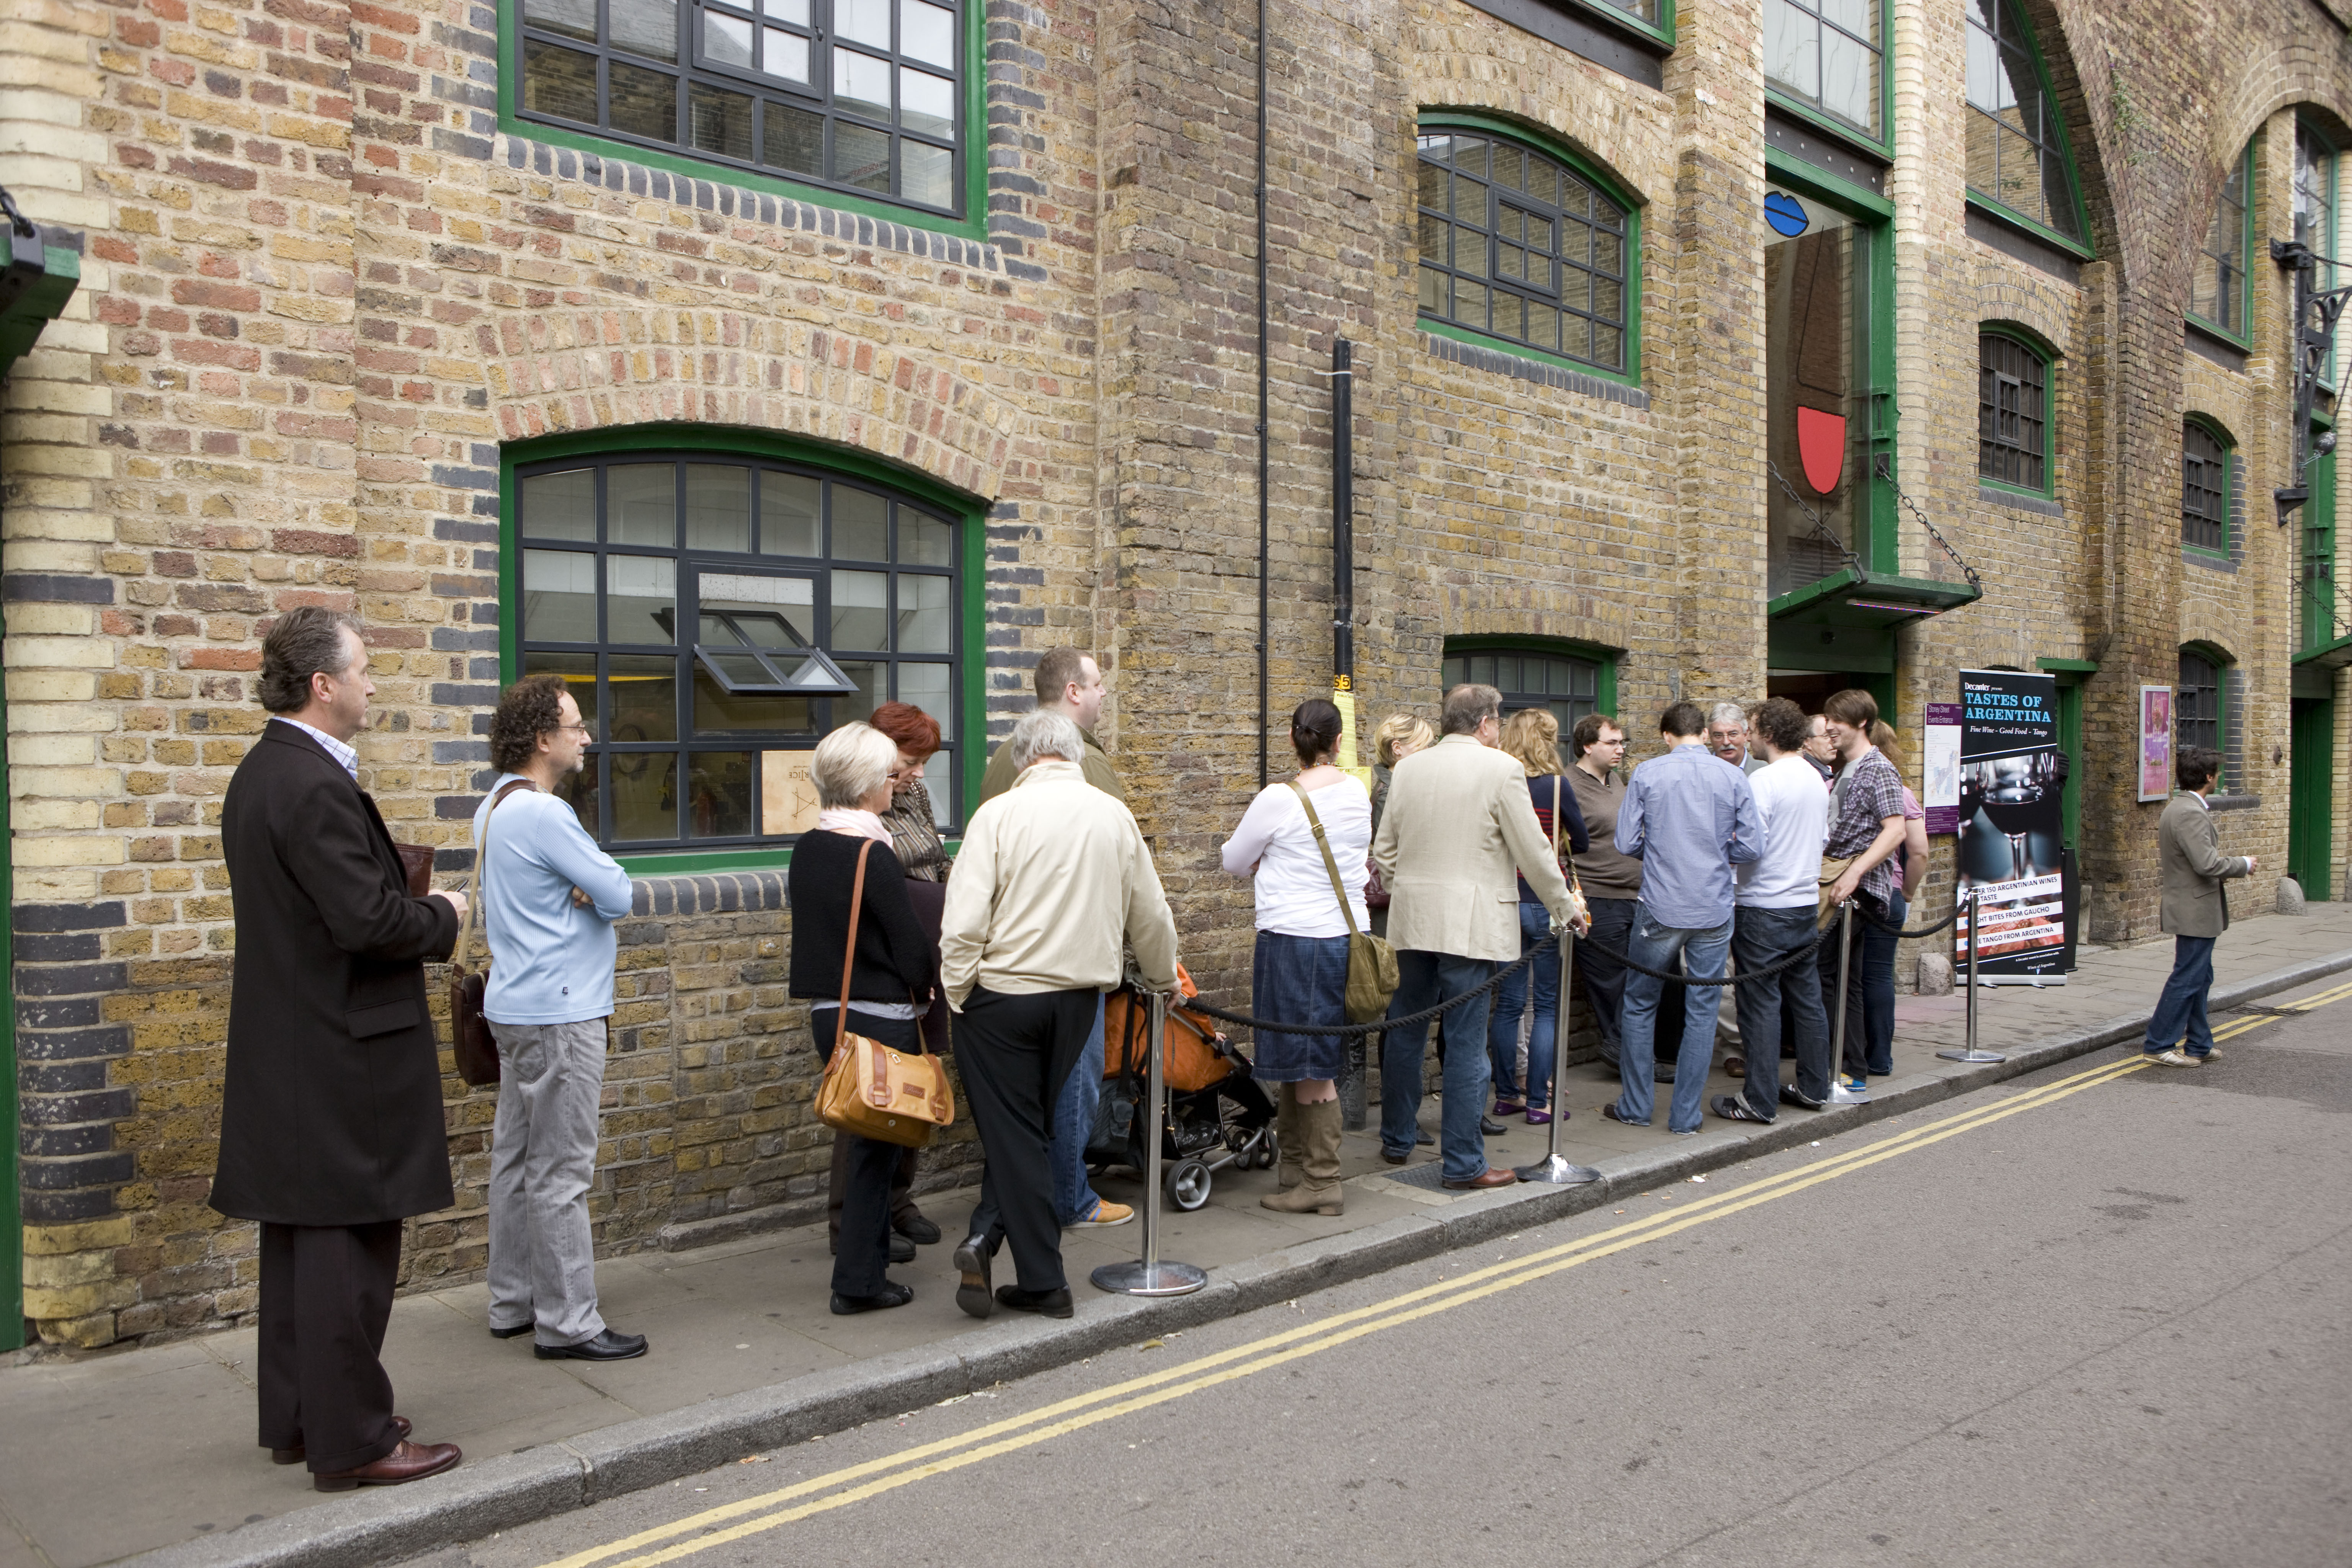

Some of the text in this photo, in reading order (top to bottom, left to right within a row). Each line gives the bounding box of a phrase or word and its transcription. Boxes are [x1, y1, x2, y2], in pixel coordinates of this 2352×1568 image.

[1965, 682, 1990, 691] Decanter
[1965, 693, 2042, 707] TASTES OF
[1965, 707, 2051, 722] ARGENTINA
[2033, 728, 2047, 737] Tango
[789, 770, 809, 781] RTICE
[1997, 879, 2038, 891] ARGENTINIAN
[2039, 876, 2057, 885] WINES
[2006, 910, 2023, 918] FROM
[2024, 906, 2050, 915] GAUCHO
[1983, 935, 2002, 943] TANGO
[2004, 931, 2020, 940] FROM
[2022, 927, 2054, 937] ARGENTINA
